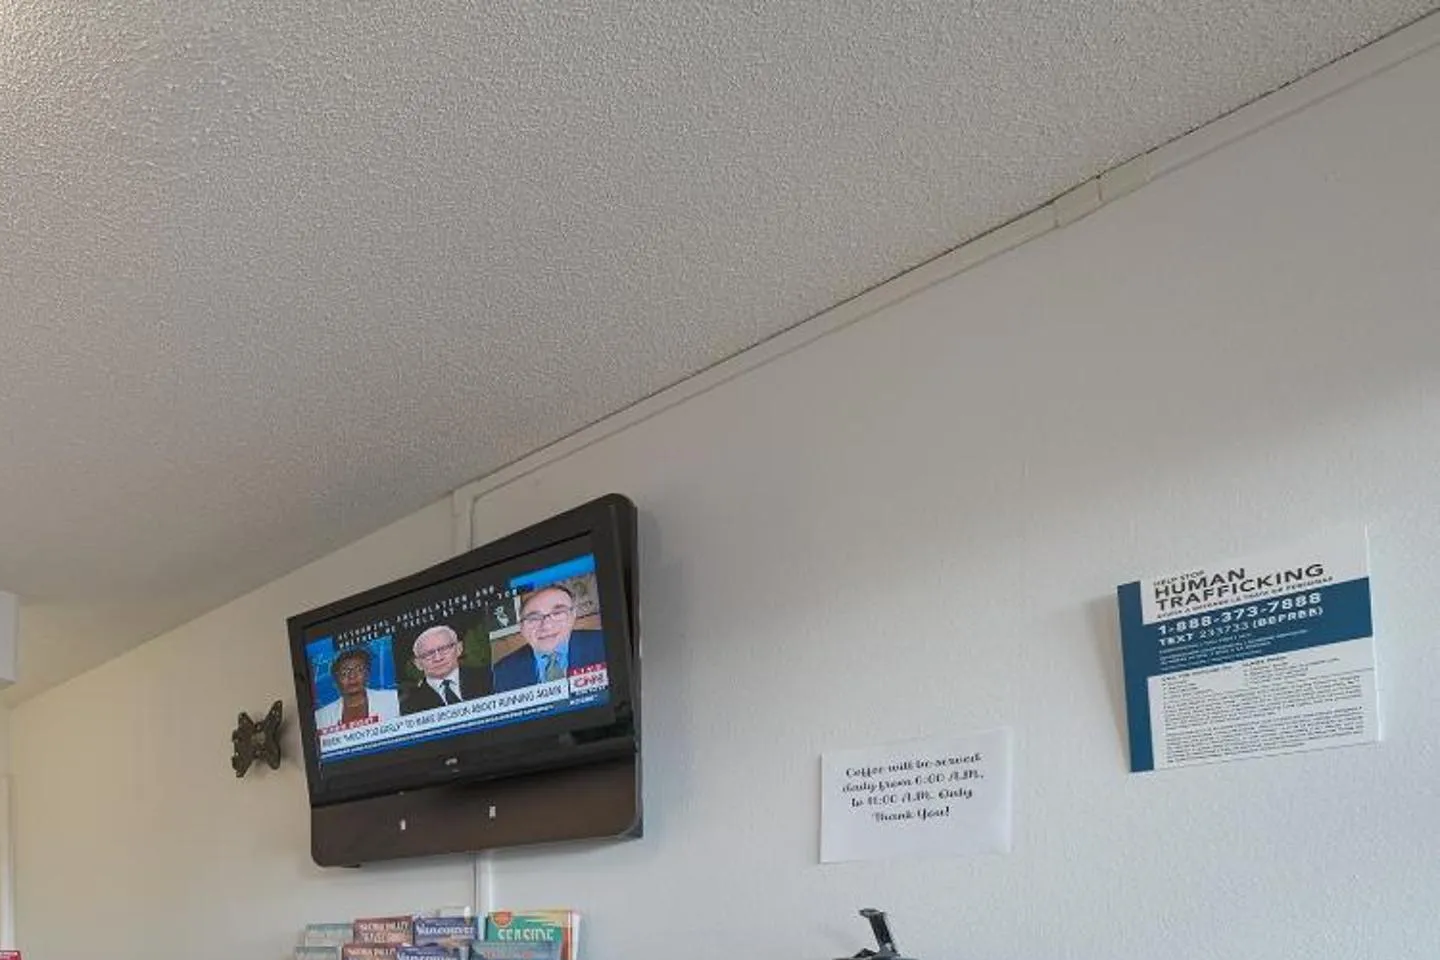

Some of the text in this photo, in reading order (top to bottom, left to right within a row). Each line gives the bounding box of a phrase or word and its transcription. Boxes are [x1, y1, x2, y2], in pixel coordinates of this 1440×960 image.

[1155, 567, 1246, 600] HUMAN
[1180, 570, 1205, 582] STOP
[1155, 564, 1325, 612] TRAFFICKING
[1158, 592, 1323, 636] 1-888-373-7888
[1159, 633, 1194, 646] TEXT
[845, 766, 883, 778] Coffee
[888, 760, 913, 772] will
[934, 753, 982, 766] served
[879, 780, 912, 792] from
[872, 805, 950, 821] Thank You!
[415, 922, 475, 937] Vancouver
